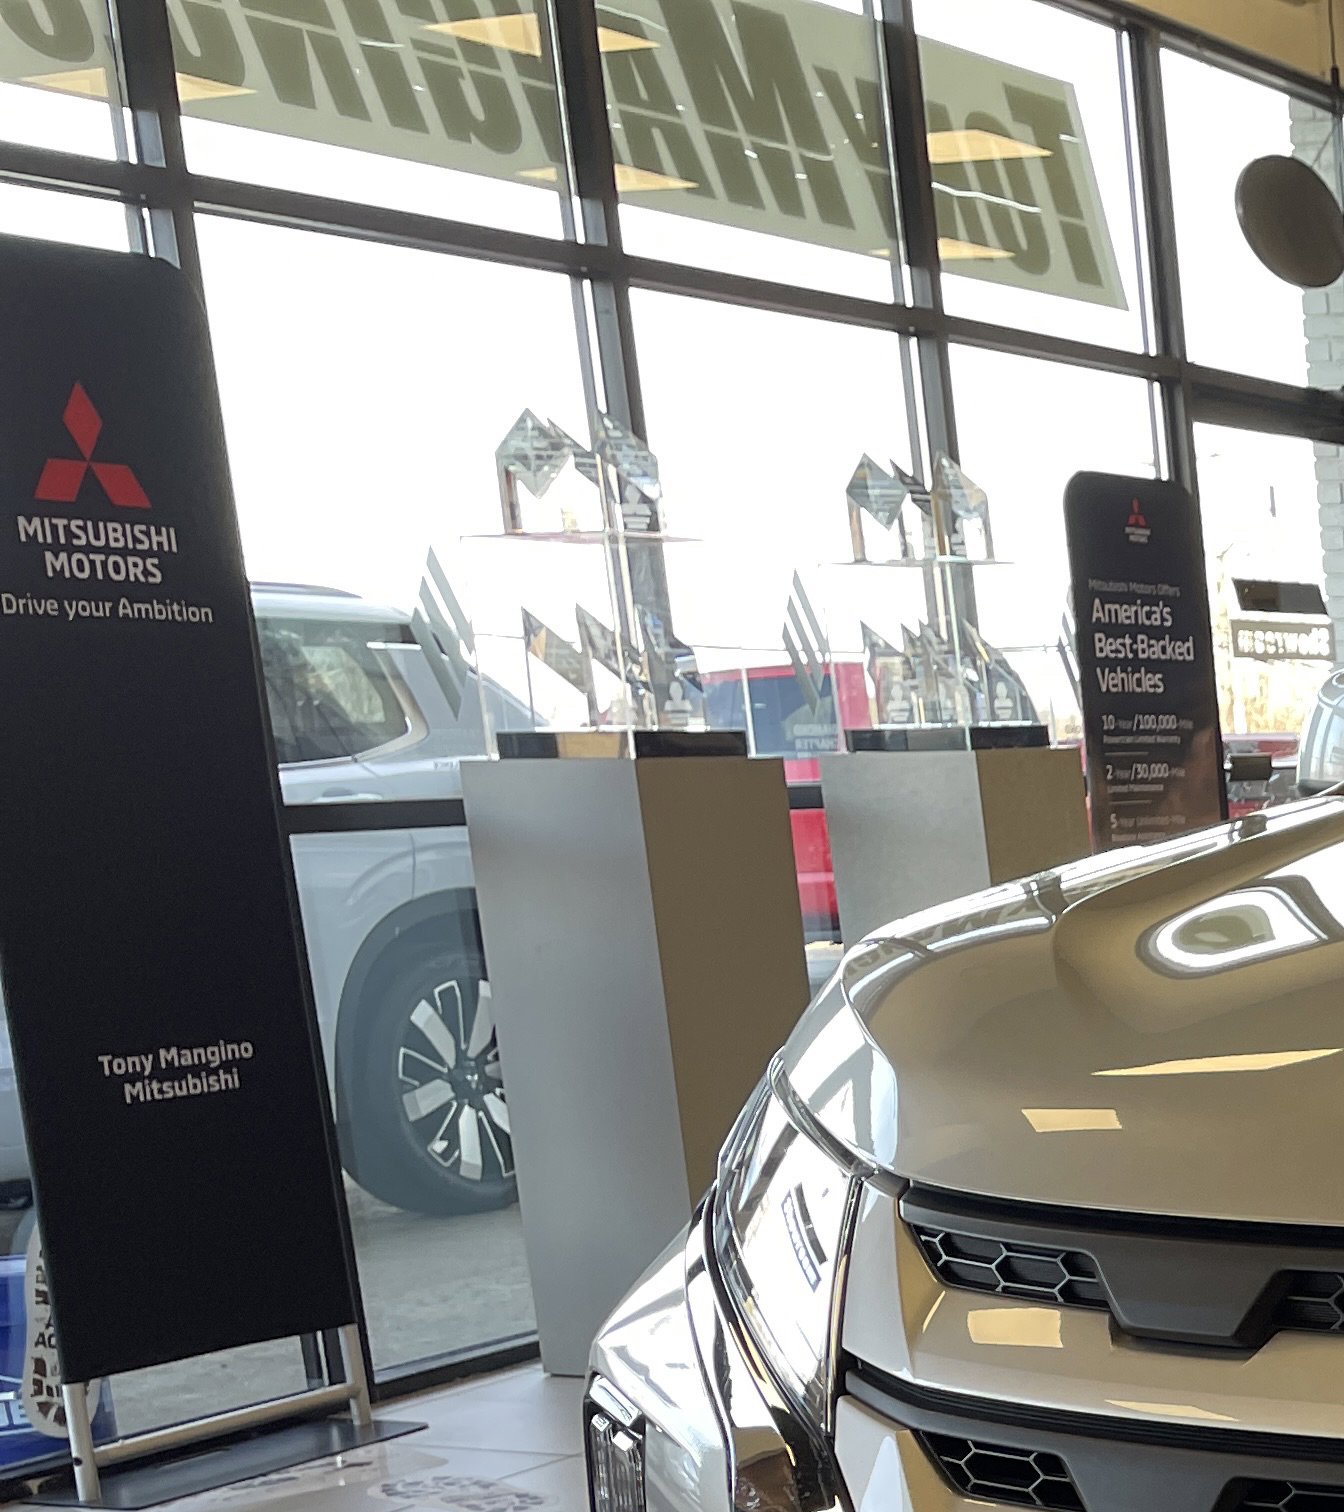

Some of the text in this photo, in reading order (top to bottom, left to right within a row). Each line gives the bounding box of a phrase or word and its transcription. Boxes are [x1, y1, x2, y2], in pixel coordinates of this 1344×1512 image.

[17, 514, 178, 554] MITSUBISHI
[44, 550, 163, 585] MOTORS
[1, 593, 214, 624] Drive your Ambition
[1091, 597, 1173, 627] America's
[1094, 632, 1195, 661] Best-Backed
[1096, 666, 1165, 693] Vehicles
[98, 1039, 254, 1077] Tony Mangino
[123, 1067, 241, 1105] Mitsubishi
